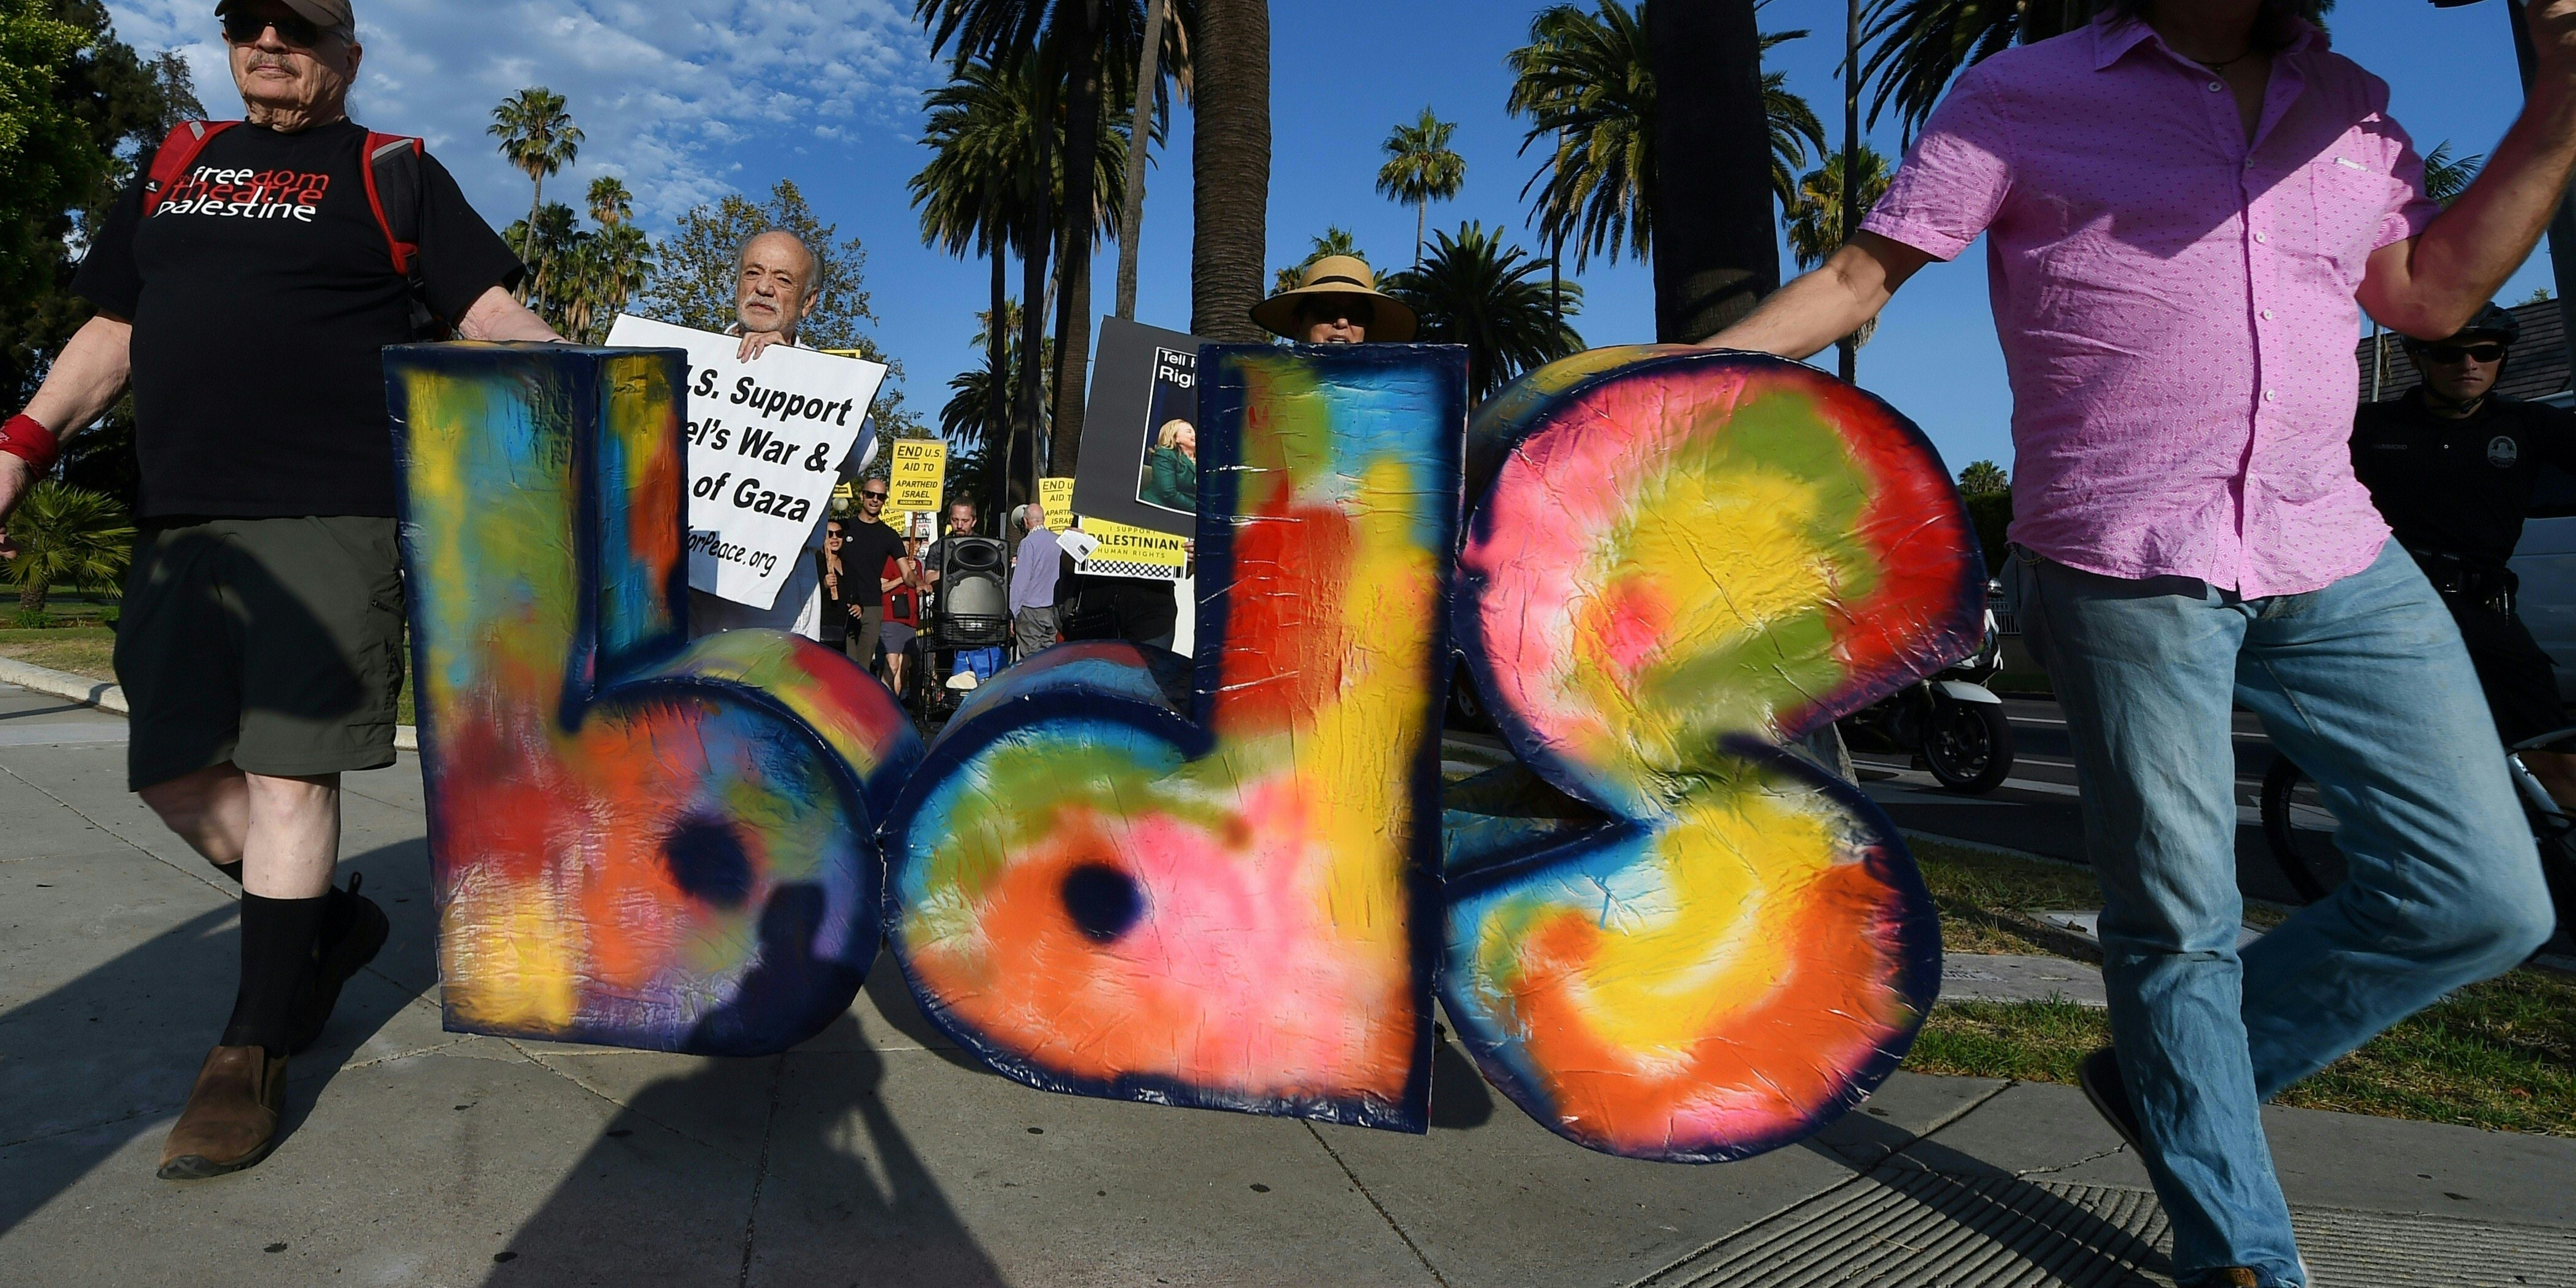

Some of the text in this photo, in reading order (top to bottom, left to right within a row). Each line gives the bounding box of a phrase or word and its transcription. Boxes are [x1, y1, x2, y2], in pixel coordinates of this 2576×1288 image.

[189, 165, 330, 191] freedom
[168, 180, 325, 206] theatre
[152, 185, 317, 223] palestine
[1161, 350, 1186, 366] Tell
[687, 365, 853, 427] .S. Support
[738, 426, 801, 466] War
[804, 442, 831, 473] &
[897, 445, 942, 458] END U.S.
[903, 462, 935, 472] AID TO
[895, 480, 938, 488] APARTHEID
[1042, 480, 1065, 490] END
[693, 472, 811, 522] of Gaza
[902, 490, 930, 498] ISRAEL
[1049, 494, 1065, 503] AID
[1116, 526, 1156, 535] SUPPORT
[1097, 548, 1166, 559] HUMAN RIGHTS
